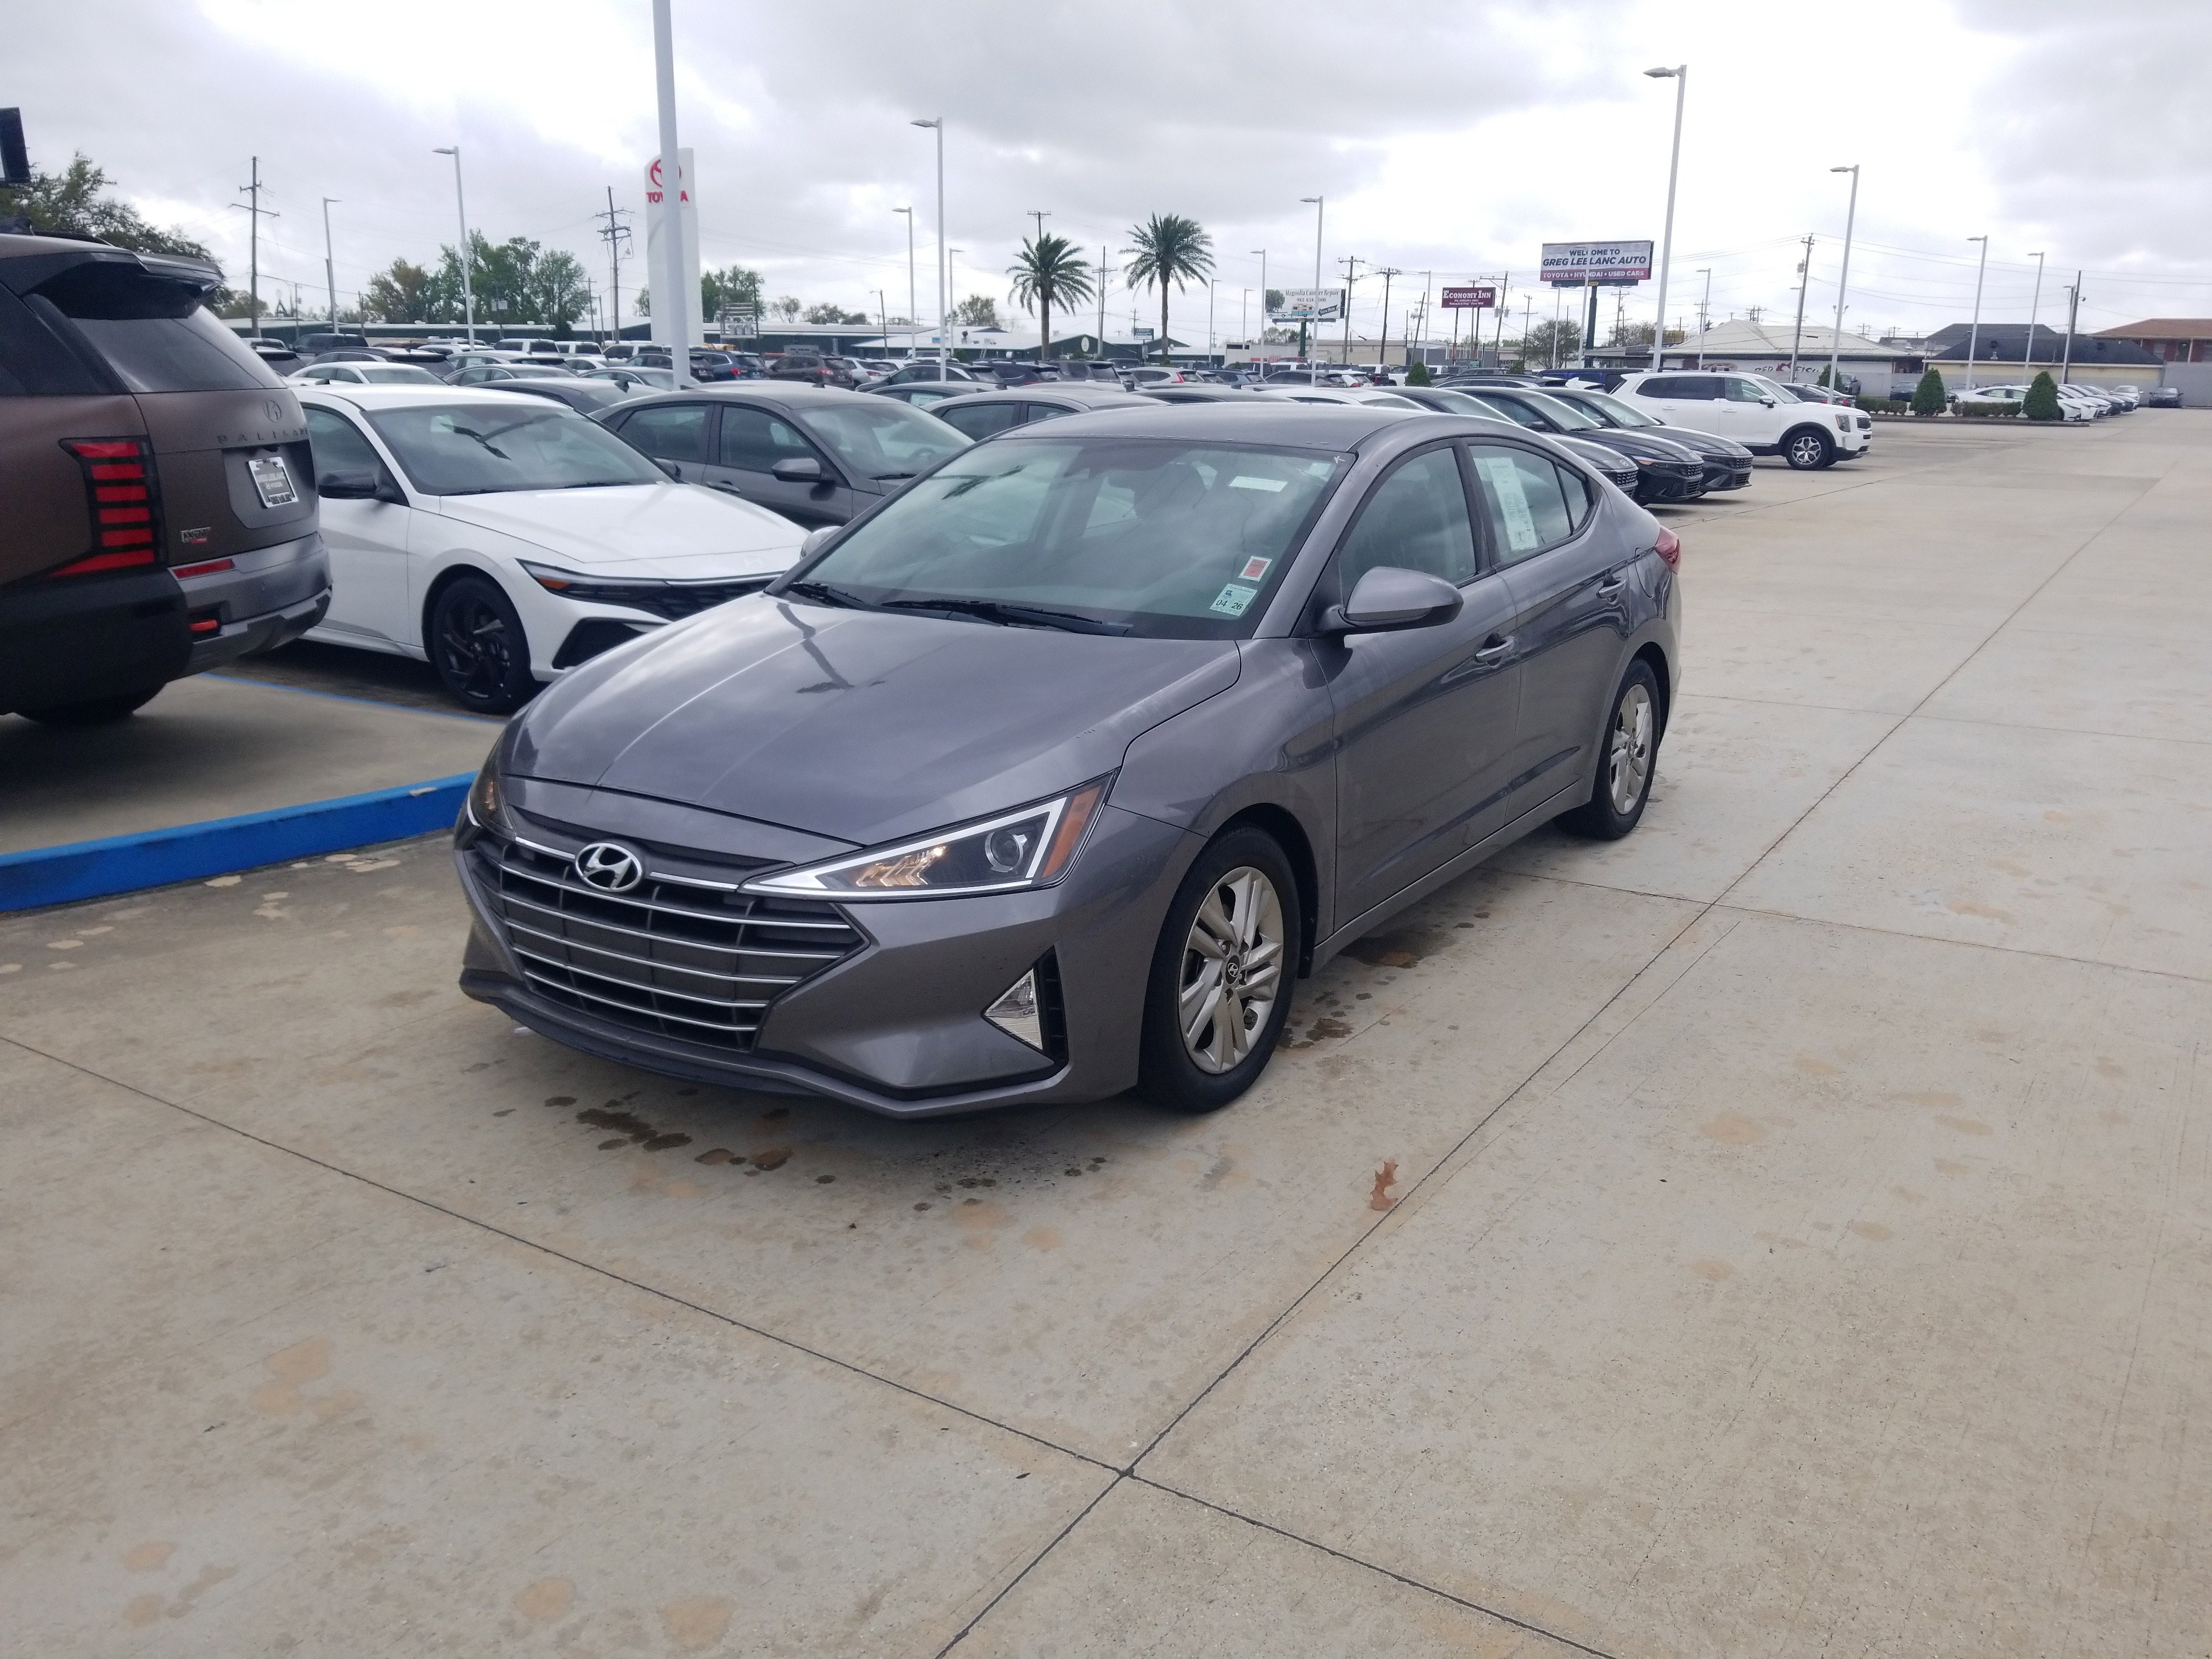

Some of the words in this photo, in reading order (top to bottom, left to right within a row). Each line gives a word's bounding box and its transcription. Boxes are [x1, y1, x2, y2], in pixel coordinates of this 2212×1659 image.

[646, 190, 689, 203] TOA
[1543, 258, 1569, 266] GREG
[1617, 256, 1646, 264] AUTO
[1443, 290, 1477, 298] ECONOMY
[1478, 290, 1492, 298] INN
